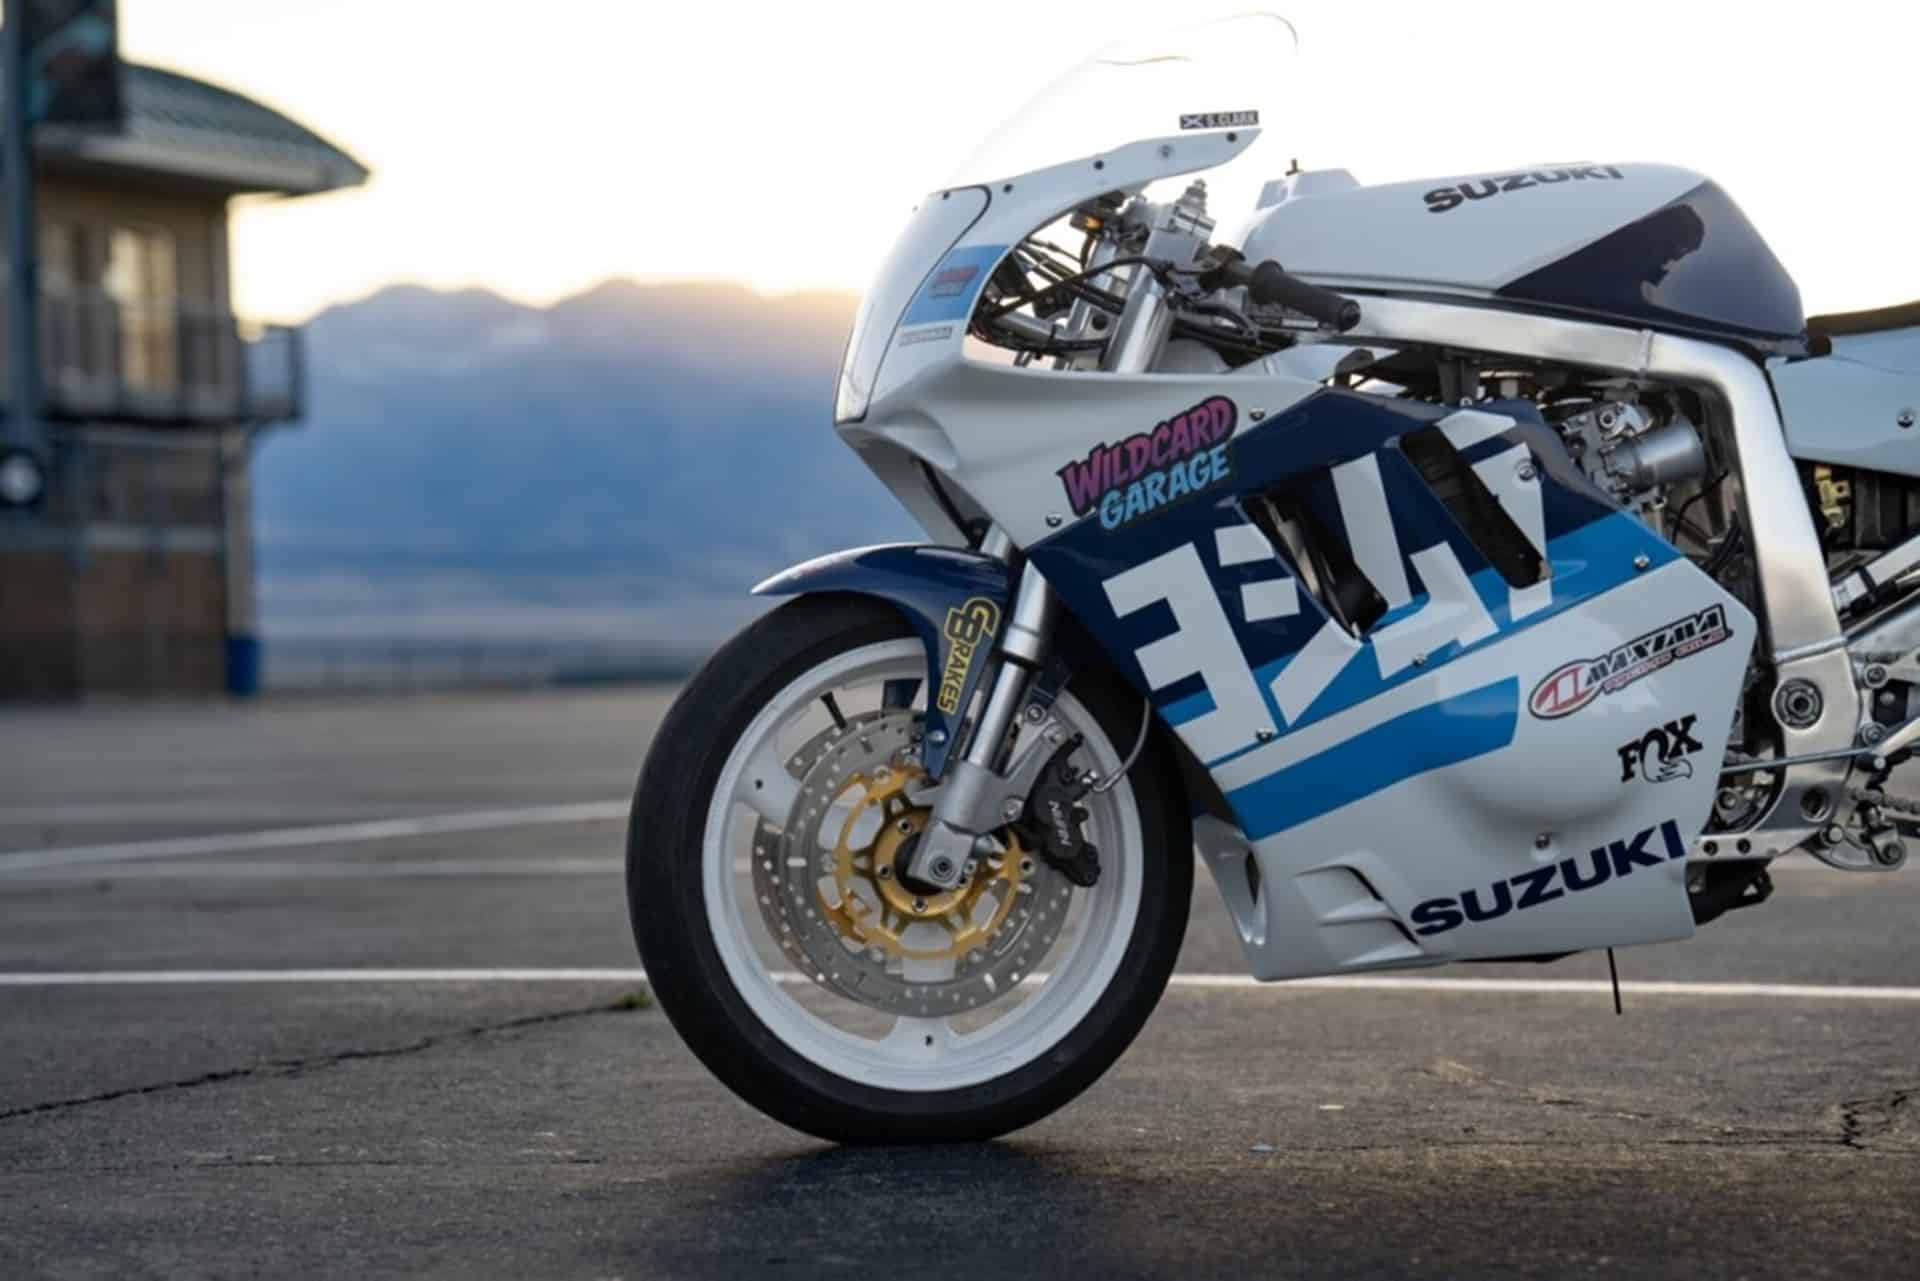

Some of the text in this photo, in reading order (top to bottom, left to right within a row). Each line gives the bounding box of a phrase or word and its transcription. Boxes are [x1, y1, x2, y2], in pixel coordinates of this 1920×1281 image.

[1424, 166, 1624, 213] SUZUKI
[1058, 397, 1236, 515] WILDCARD
[1100, 443, 1231, 529] GARAGE
[1617, 713, 1703, 783] FOX
[1410, 819, 1686, 936] SUZUKI
